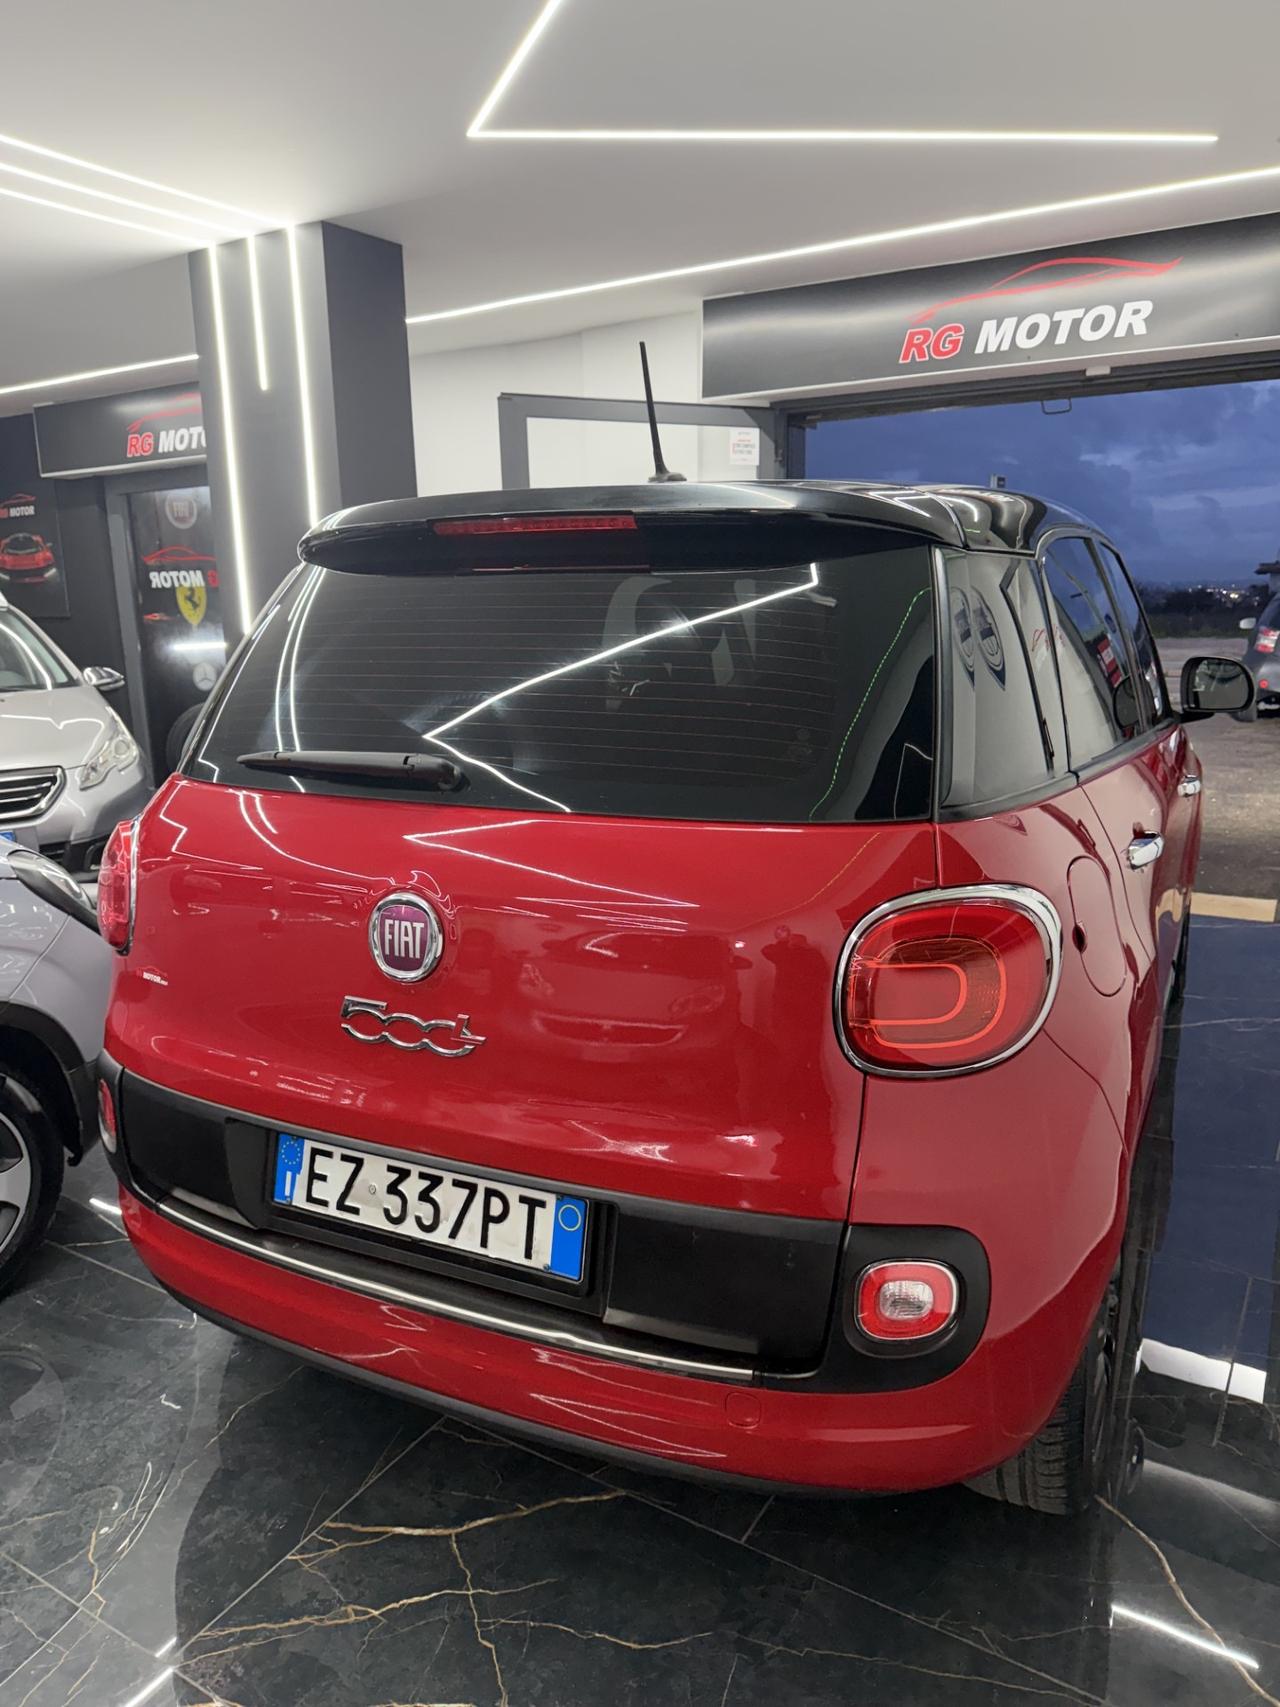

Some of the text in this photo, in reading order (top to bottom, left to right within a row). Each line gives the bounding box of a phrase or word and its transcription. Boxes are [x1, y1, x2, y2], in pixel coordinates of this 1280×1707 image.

[899, 300, 1153, 364] RG MOTOR
[127, 431, 154, 458] RG
[10, 505, 35, 517] MOTOR
[384, 919, 425, 959] FIAT
[305, 1147, 364, 1216] EZ
